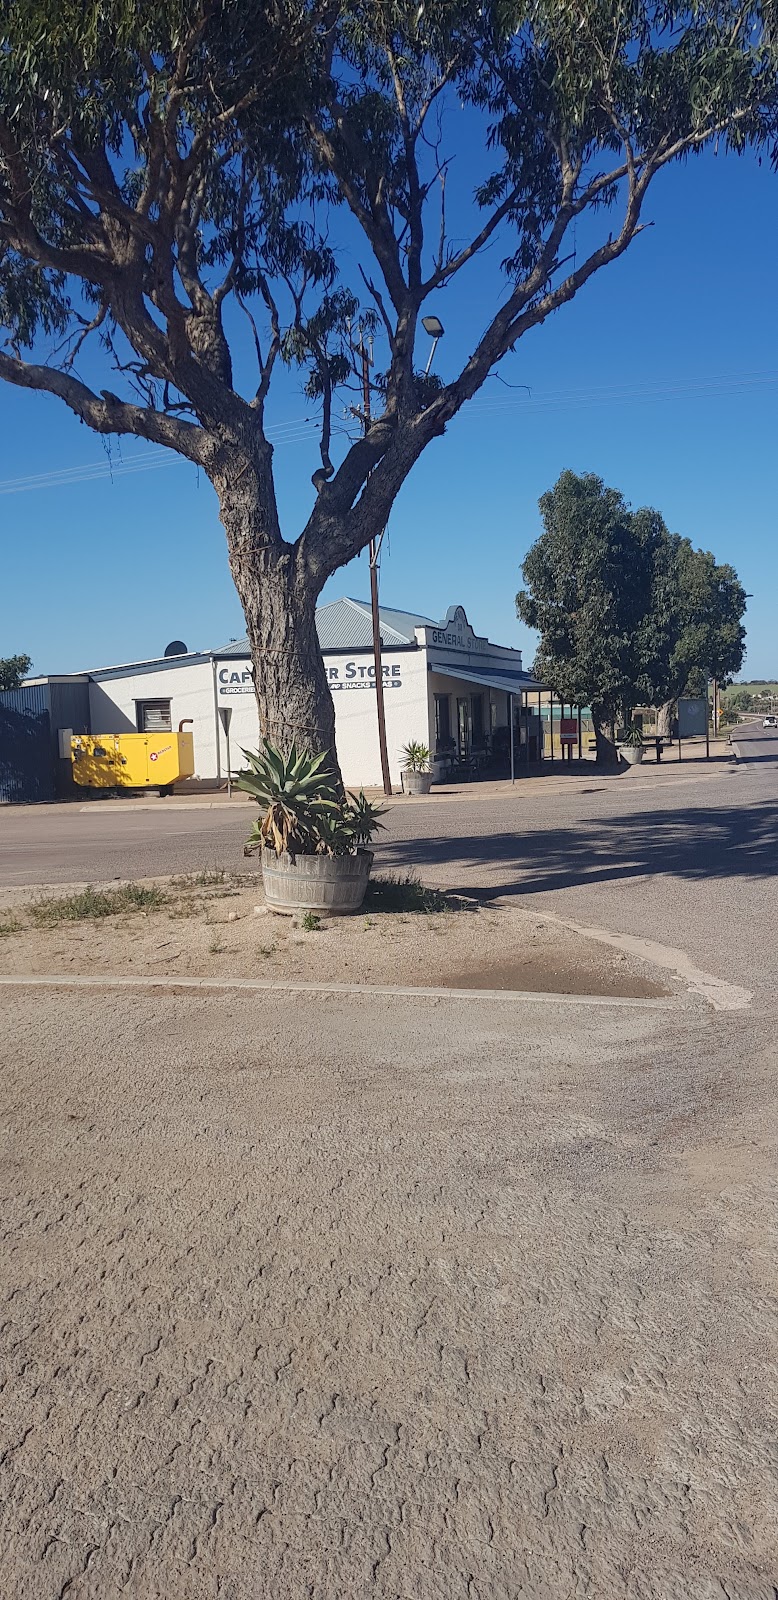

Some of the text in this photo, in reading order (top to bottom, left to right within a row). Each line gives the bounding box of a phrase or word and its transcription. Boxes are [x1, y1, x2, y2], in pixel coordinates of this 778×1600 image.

[432, 631, 486, 651] GENERAL STORE
[346, 662, 401, 679] STORE
[342, 681, 371, 690] SNACKS
